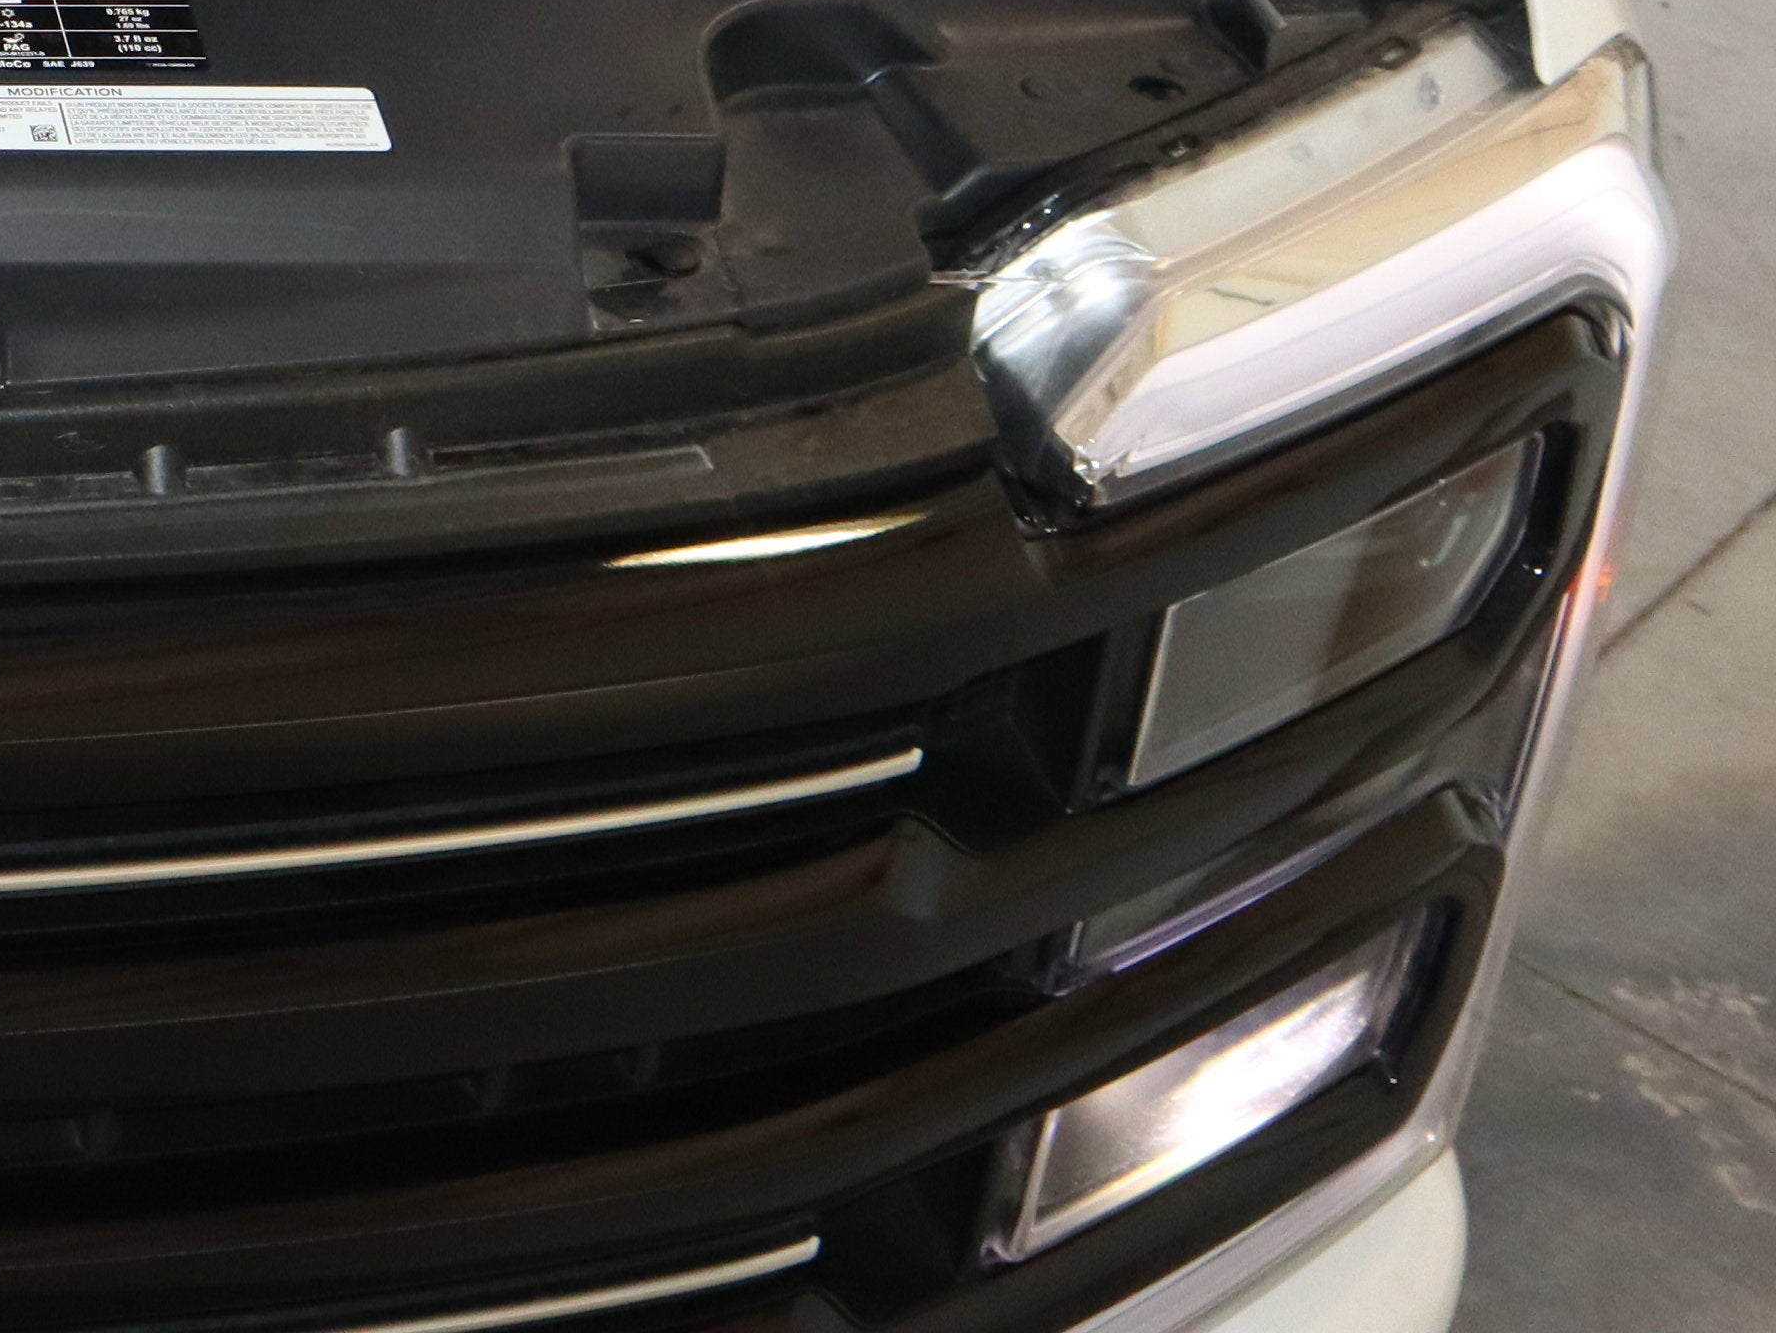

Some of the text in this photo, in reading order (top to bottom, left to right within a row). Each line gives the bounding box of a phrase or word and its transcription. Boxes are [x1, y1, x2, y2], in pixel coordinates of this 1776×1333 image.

[105, 8, 151, 17] 0.765 kg
[113, 35, 131, 43] 3.7
[133, 35, 142, 43] fl
[2, 43, 31, 52] PAG
[117, 44, 163, 54] (110 cc)
[42, 60, 67, 69] SAE
[70, 60, 96, 69] J639
[7, 87, 123, 97] MODIFICATION
